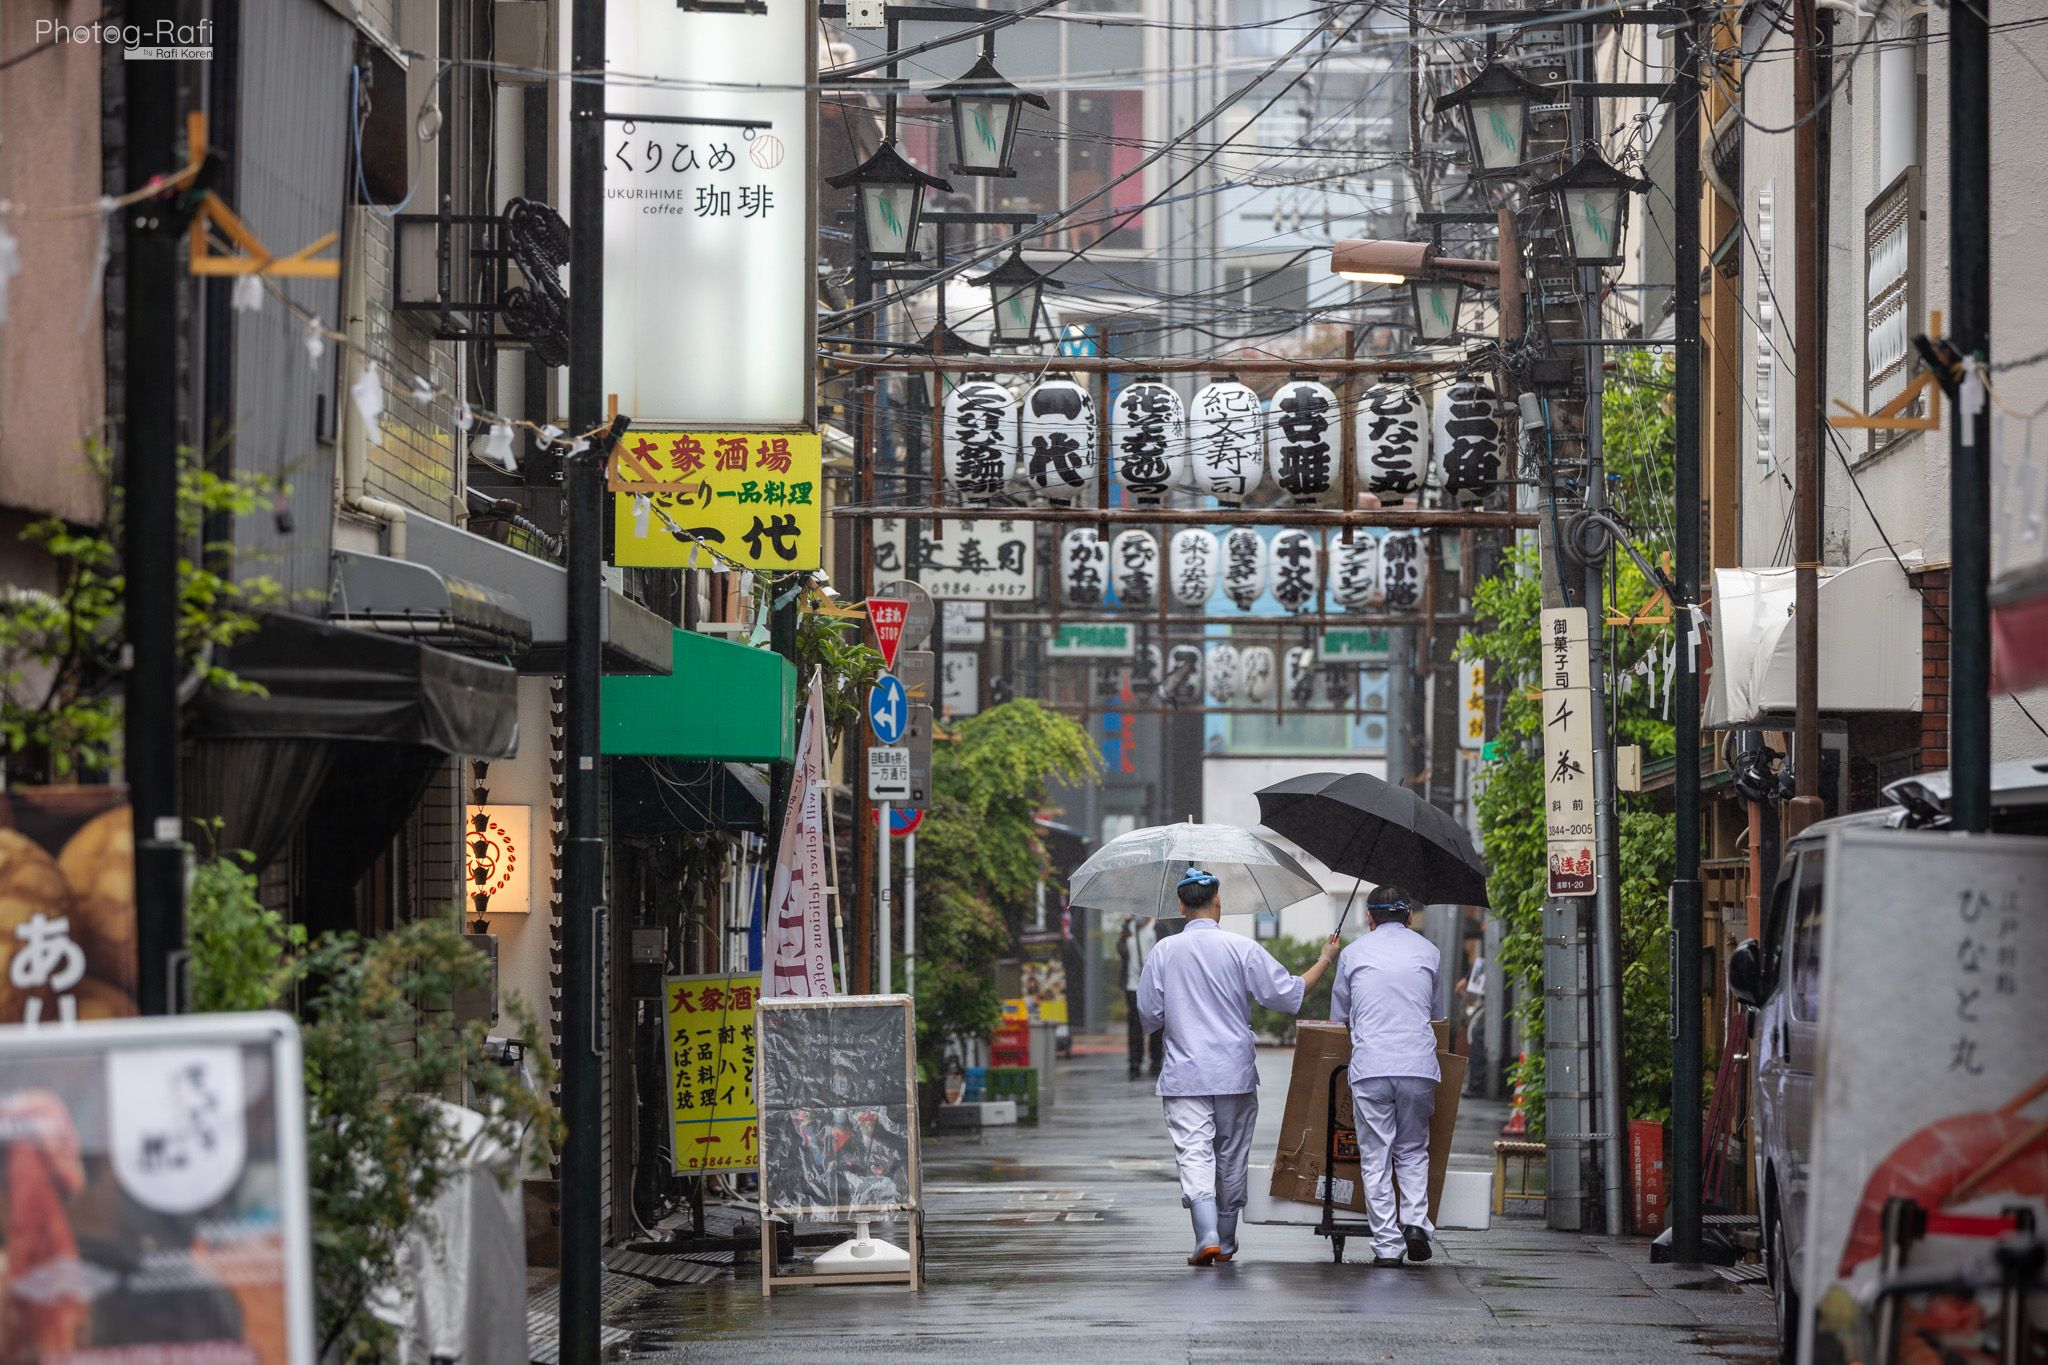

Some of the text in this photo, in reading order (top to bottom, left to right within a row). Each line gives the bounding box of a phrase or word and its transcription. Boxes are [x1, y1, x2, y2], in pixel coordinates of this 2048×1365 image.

[602, 141, 736, 173] くりひめ
[602, 188, 683, 200] UKURIHIME
[643, 203, 684, 215] coffee
[694, 184, 774, 218] 珈琲
[626, 434, 793, 474] 大衆酒場
[1029, 388, 1085, 487] 一代
[1203, 387, 1250, 495] 紀文寿司
[1362, 387, 1422, 494] ひなと丸
[672, 513, 802, 561] 一代
[875, 606, 902, 623] 止まれ
[880, 627, 899, 640] STOP
[1553, 618, 1569, 689] 御菓子司
[1548, 698, 1586, 784] 千茶
[871, 767, 908, 781] 一方通行
[1548, 824, 1594, 836] 3844-2005
[1560, 856, 1591, 875] 浅草
[1556, 881, 1584, 889] 浅草1-20
[669, 986, 761, 1014] 大衆酒
[1947, 888, 1990, 1075] ひなと丸
[673, 1028, 694, 1110] ろばた焼
[696, 1029, 718, 1107] 一品料理
[718, 1025, 737, 1105] 酎ハイ
